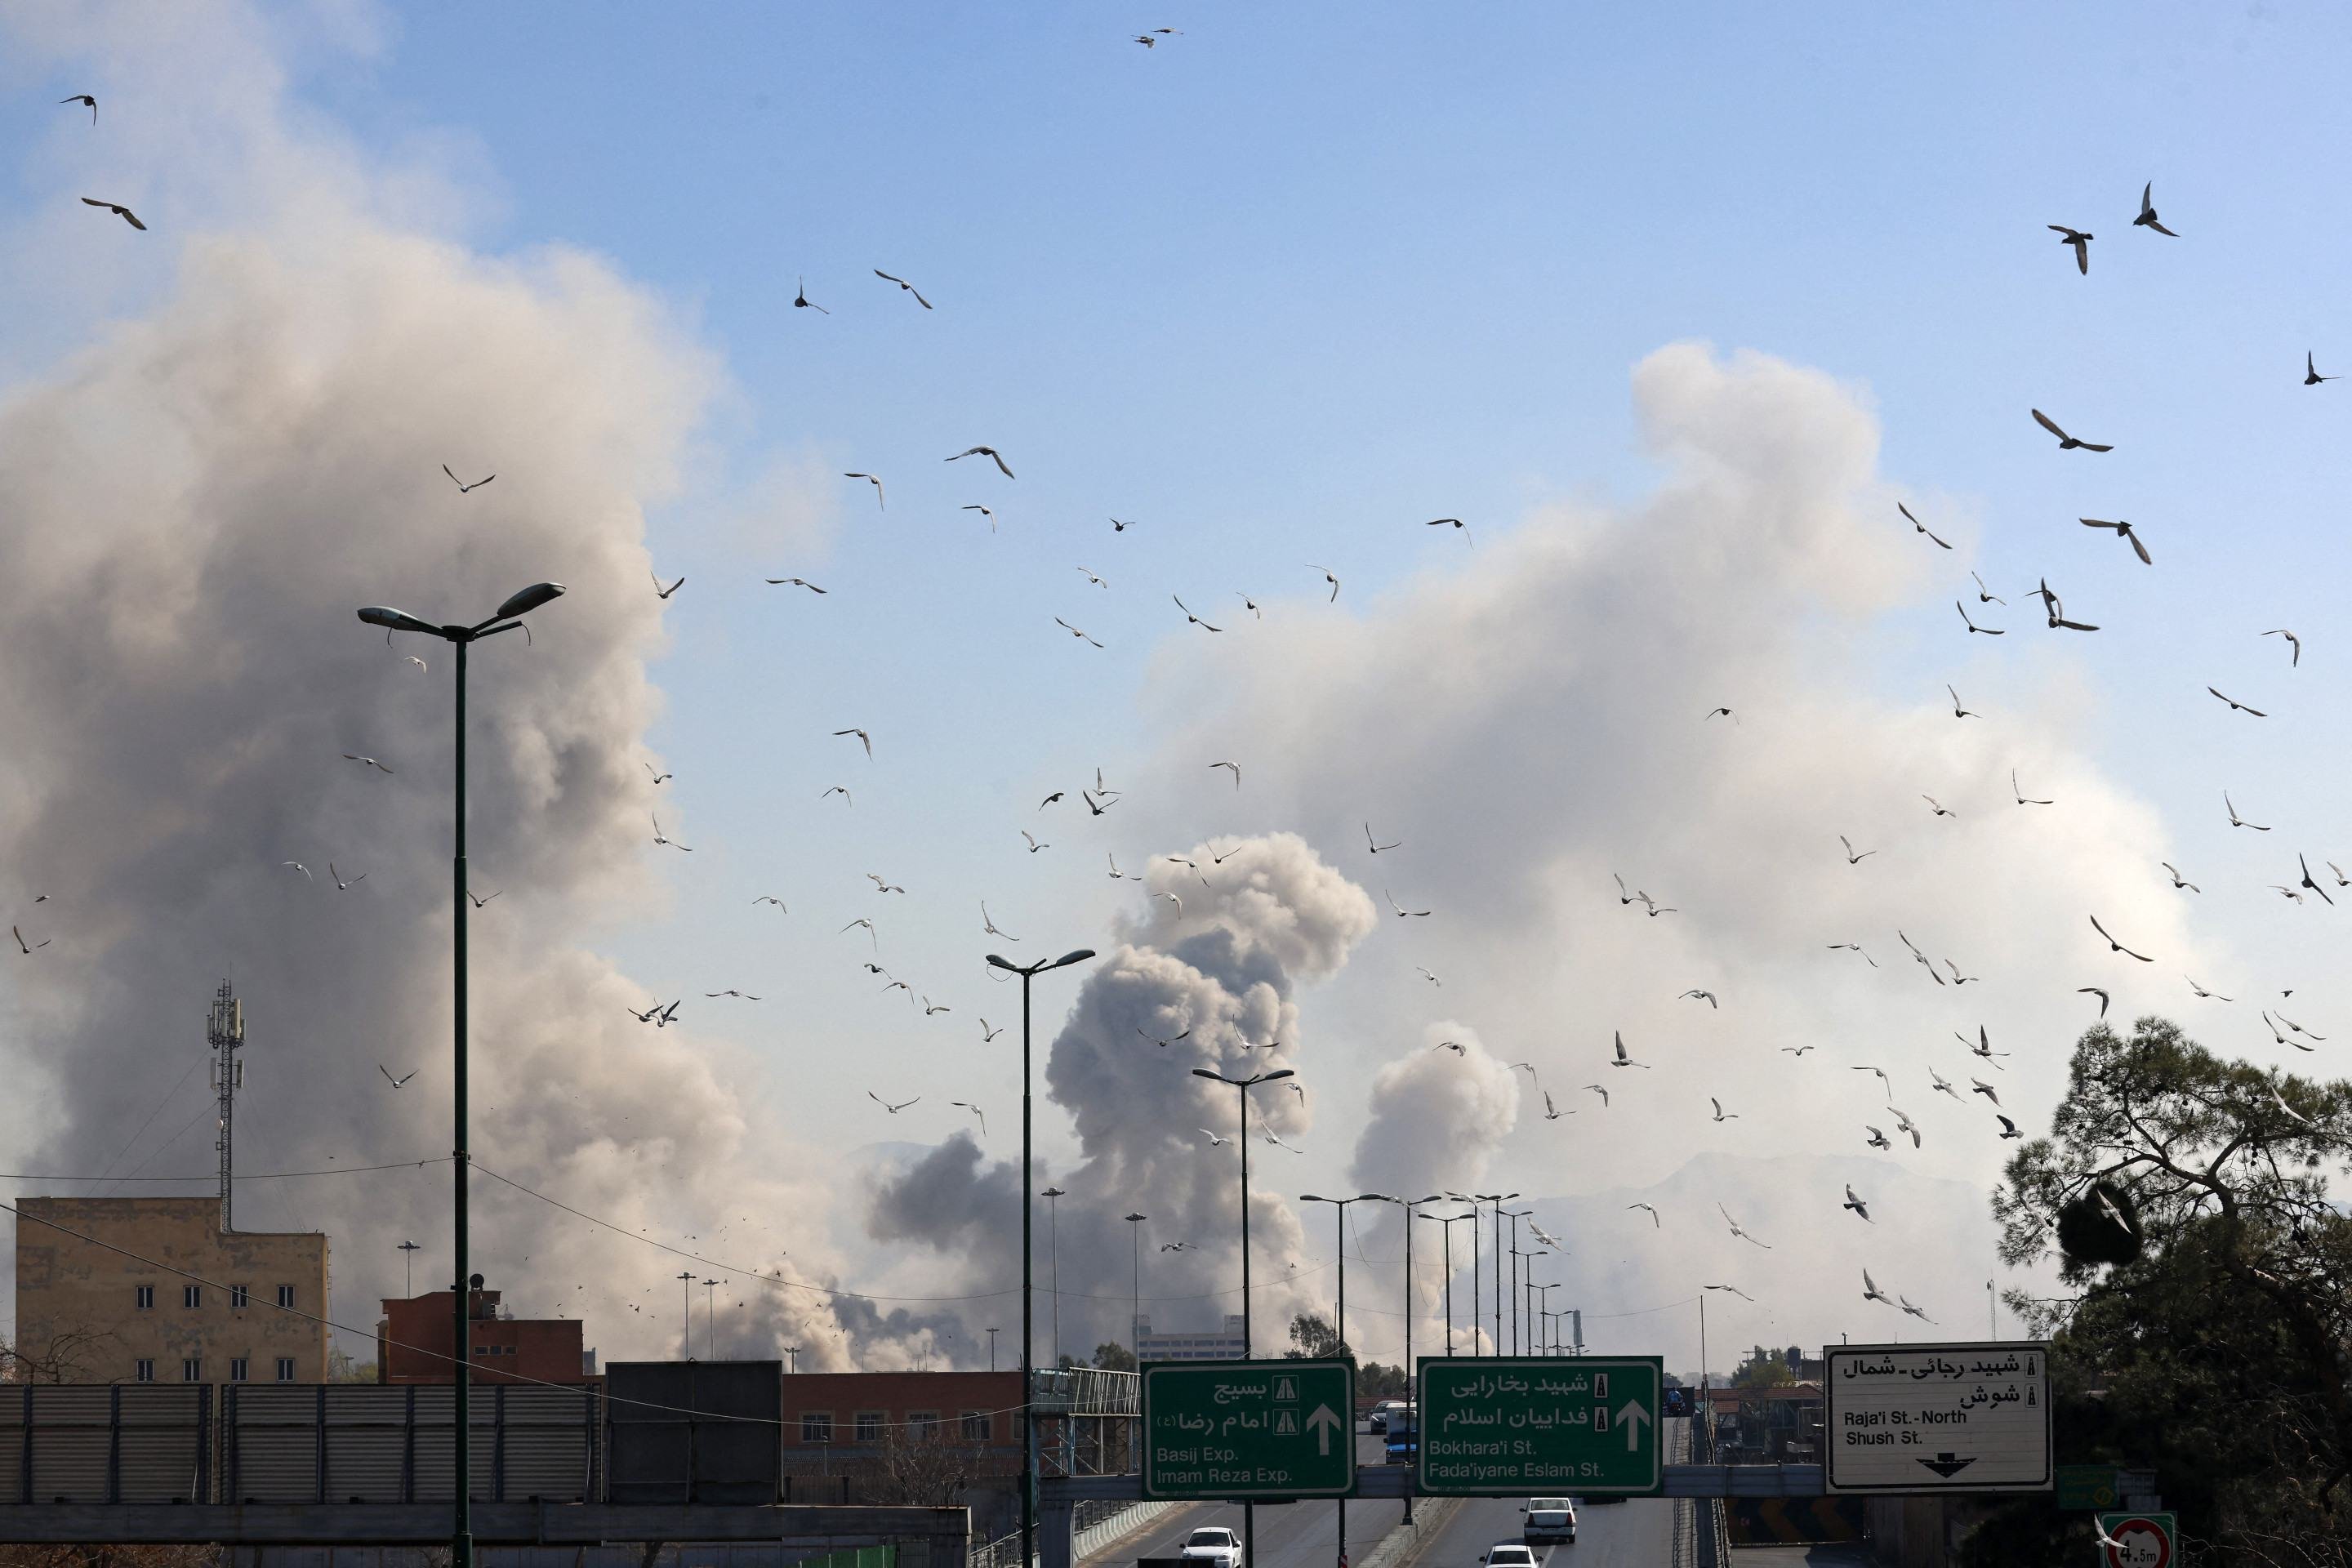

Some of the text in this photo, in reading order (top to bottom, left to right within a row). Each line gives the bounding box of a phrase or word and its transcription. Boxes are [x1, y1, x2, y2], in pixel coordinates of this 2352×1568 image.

[1844, 1356, 1895, 1379] شمال
[1911, 1357, 1965, 1379] رجائی
[1971, 1354, 2020, 1376] شهید
[1214, 1384, 1267, 1405] بسیج
[1451, 1373, 1588, 1399] شهید بخارایی
[1960, 1384, 2020, 1410] شوش
[1223, 1410, 1268, 1437] امام
[1443, 1405, 1588, 1432] فداییان اسلام
[1844, 1410, 1886, 1428] Raja'i
[1429, 1440, 1537, 1456] Bokhara'i St.
[1846, 1430, 1922, 1446] Shush St.
[1156, 1446, 1240, 1464] Basij Exp.
[1156, 1467, 1293, 1485] Imam Reza Exp.
[1429, 1462, 1605, 1480] Fada'iyane Eslam St.
